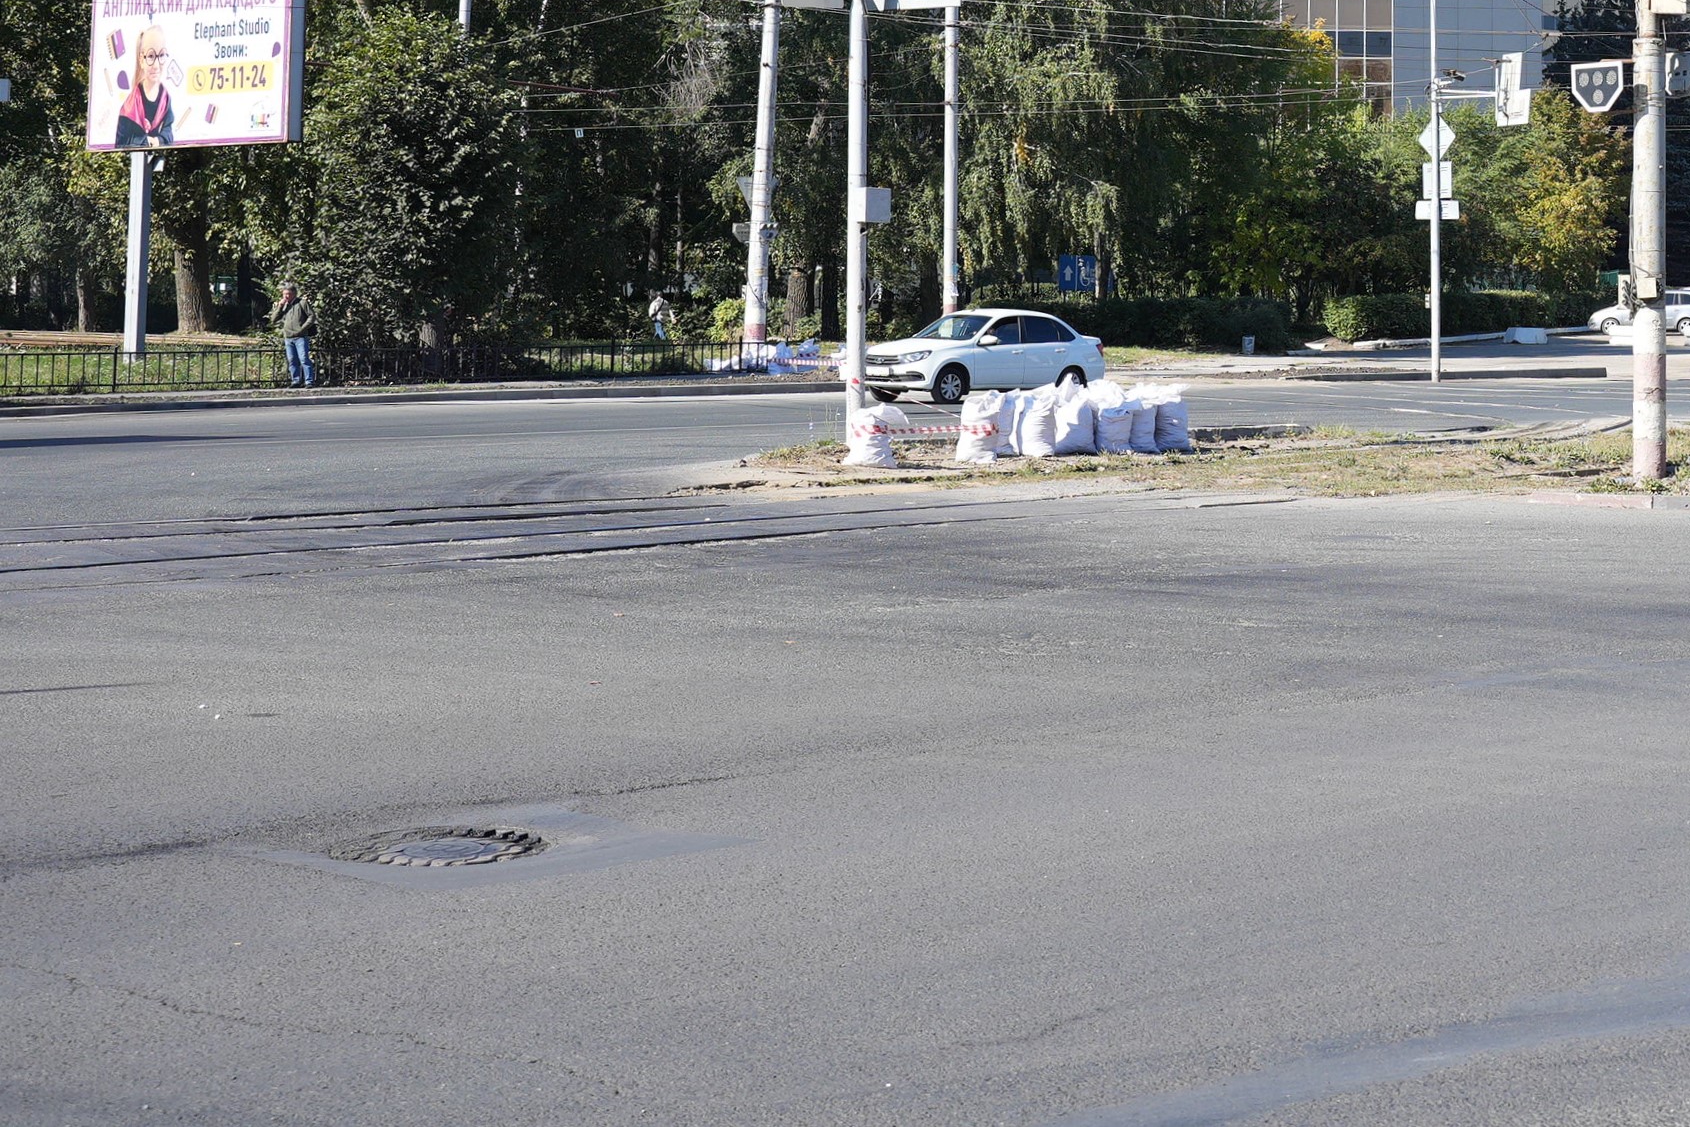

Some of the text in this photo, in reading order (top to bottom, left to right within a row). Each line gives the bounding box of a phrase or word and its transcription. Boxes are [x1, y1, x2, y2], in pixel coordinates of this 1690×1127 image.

[194, 17, 270, 42] Elephant Studio
[214, 42, 249, 60] Звони:
[210, 64, 267, 90] 75-11-24
